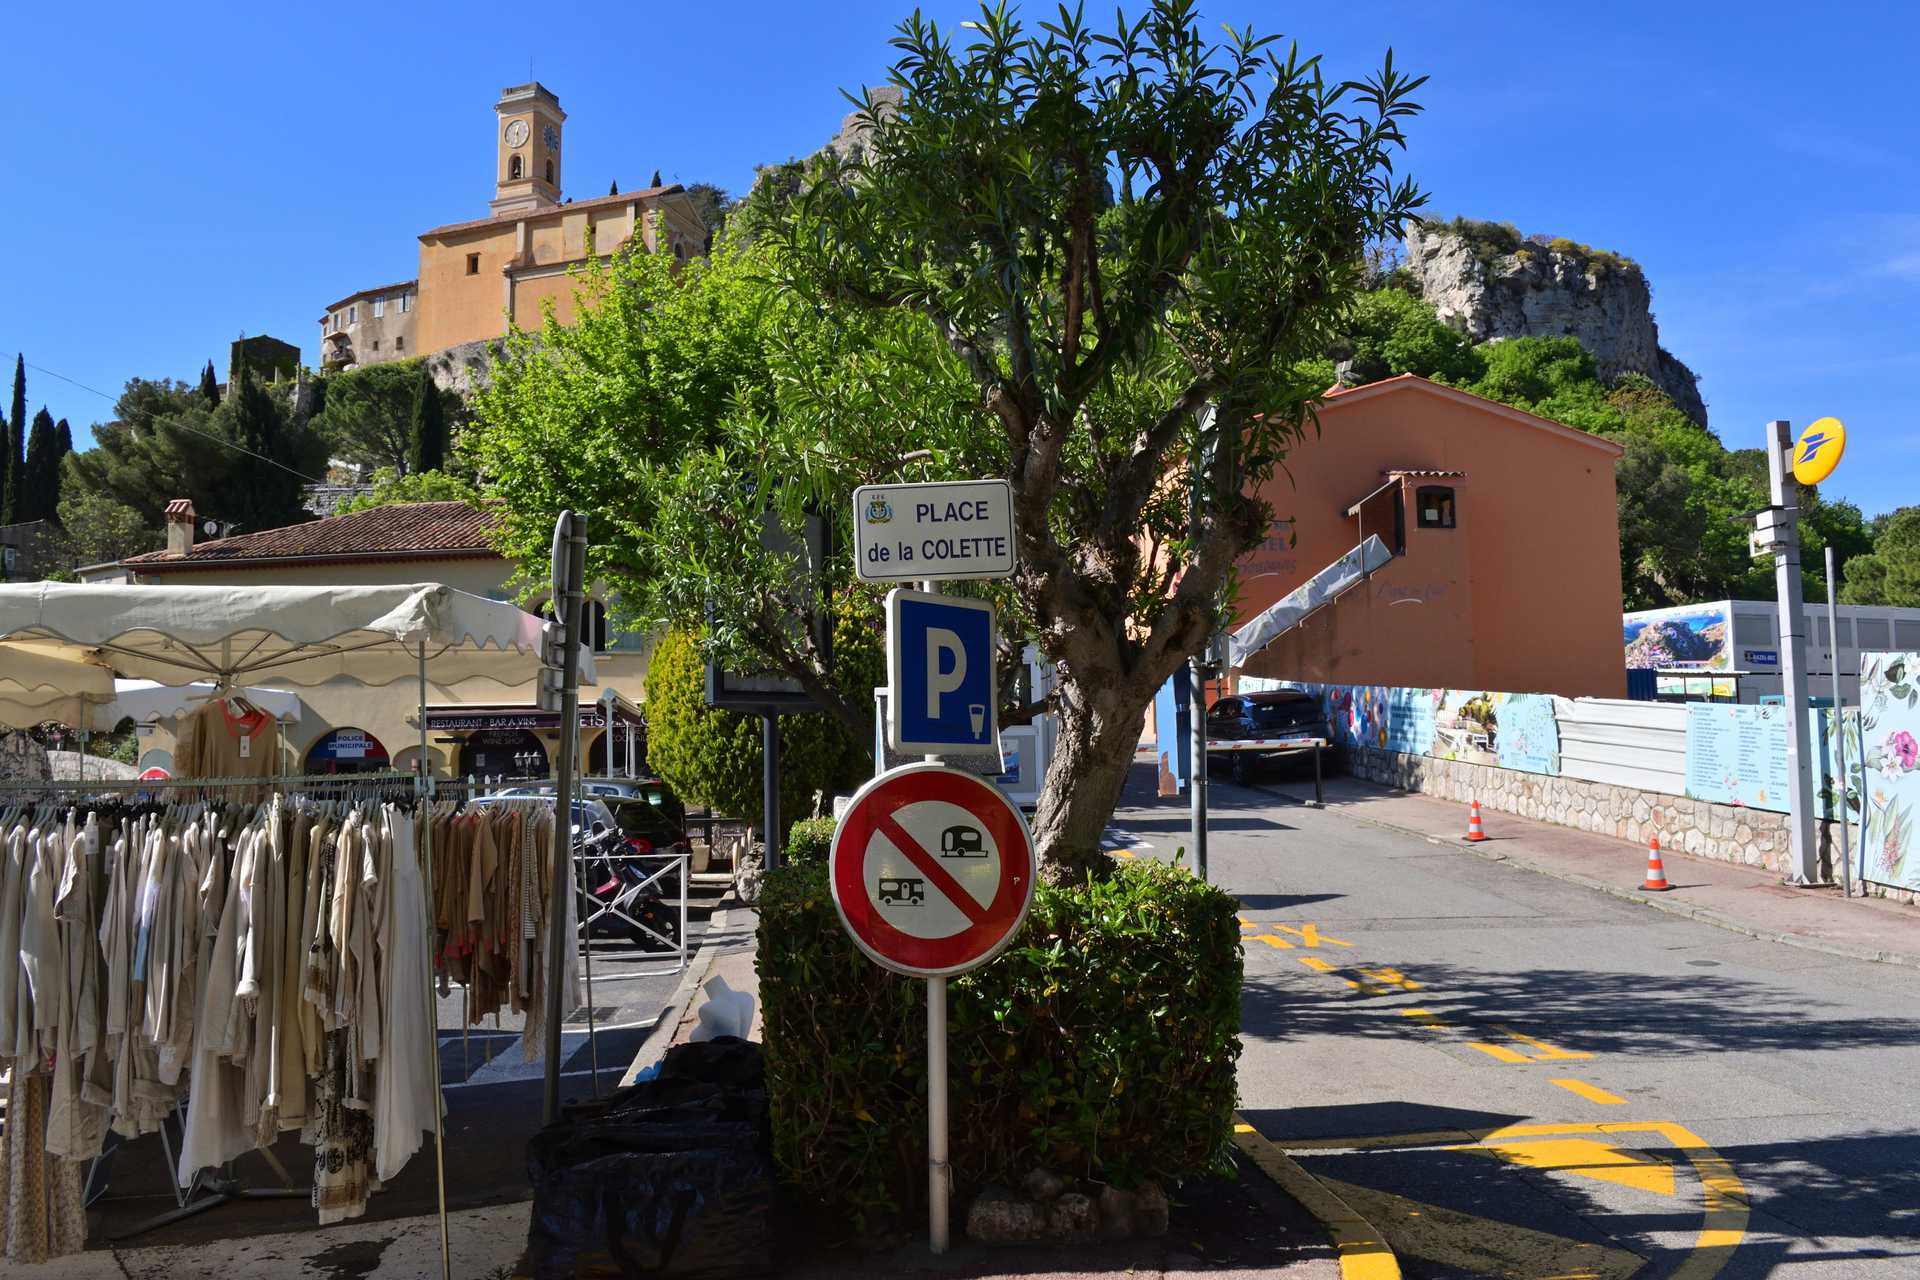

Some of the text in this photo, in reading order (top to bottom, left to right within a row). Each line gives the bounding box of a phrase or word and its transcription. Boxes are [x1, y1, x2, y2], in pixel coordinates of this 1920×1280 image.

[916, 500, 989, 523] PLACE
[868, 537, 1006, 562] de la COLETTE
[926, 626, 968, 720] P
[431, 718, 482, 729] RESTAURANT
[490, 718, 506, 727] BAR
[517, 716, 537, 727] VINS
[503, 736, 525, 745] SHOP
